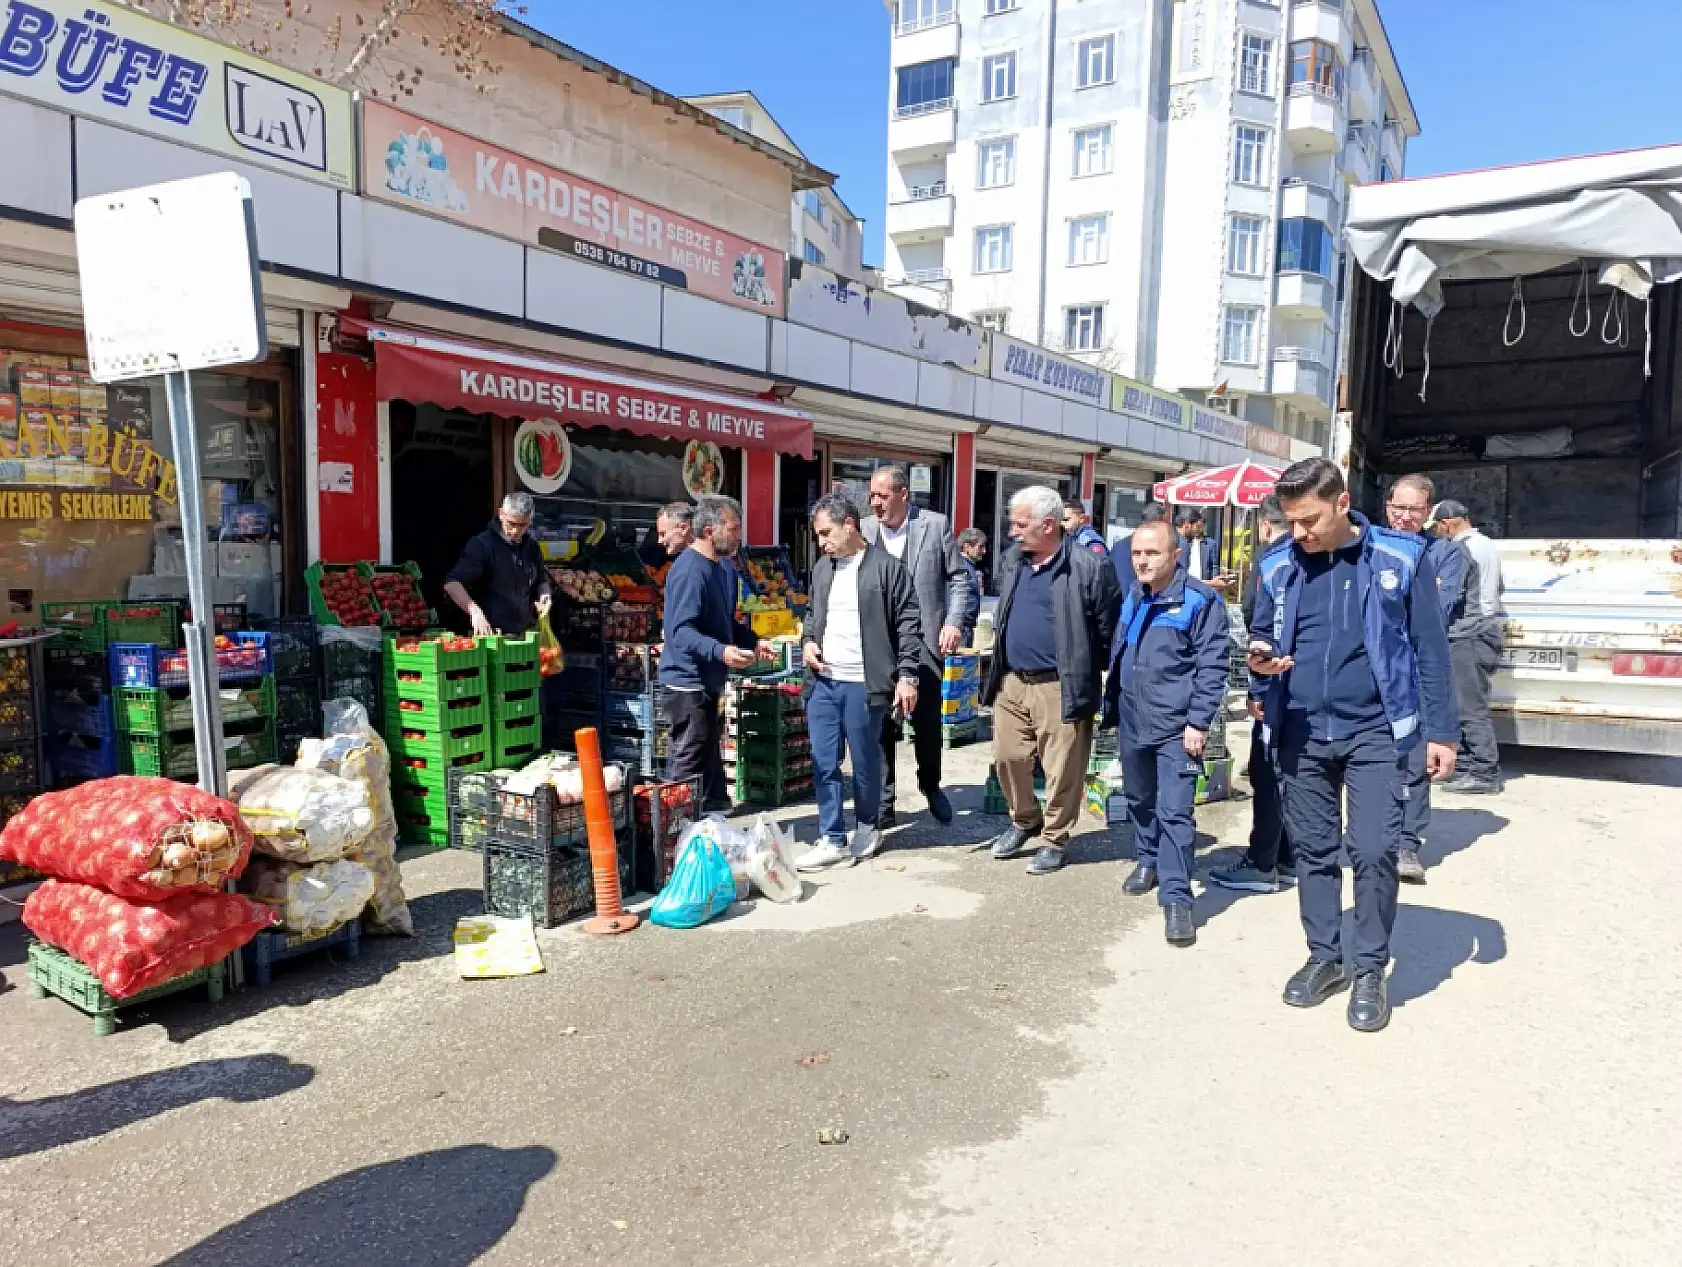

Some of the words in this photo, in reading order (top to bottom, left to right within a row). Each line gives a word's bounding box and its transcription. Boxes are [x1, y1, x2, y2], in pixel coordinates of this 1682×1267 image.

[0, 0, 209, 125] BÜFE
[475, 150, 665, 251] KARDEŞLER
[666, 222, 712, 252] SEBZE
[715, 239, 726, 257] &
[671, 246, 721, 277] MEYVE
[460, 368, 611, 415] KARDEŞLER
[617, 394, 682, 426] SEBZE
[687, 409, 701, 429] &
[706, 411, 765, 439] MEYVE
[84, 422, 178, 505] BÜFE
[1527, 651, 1558, 664] 280
